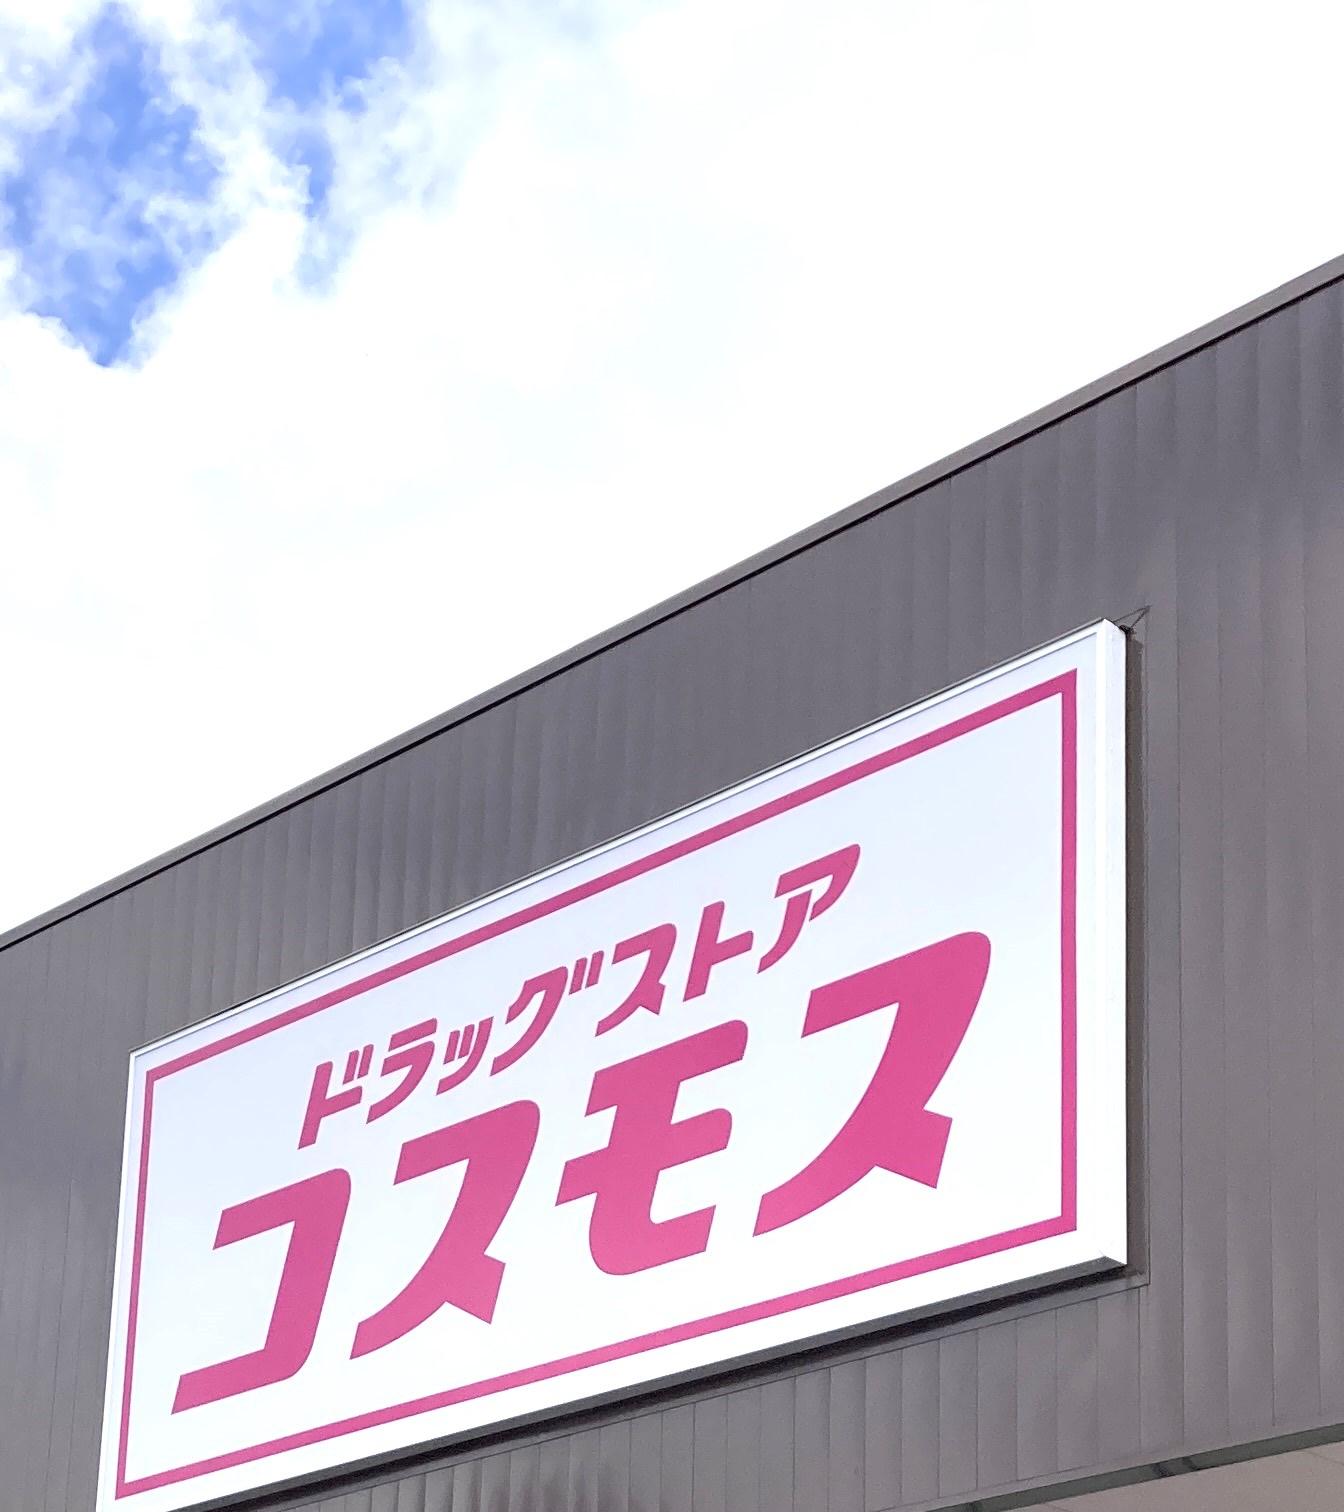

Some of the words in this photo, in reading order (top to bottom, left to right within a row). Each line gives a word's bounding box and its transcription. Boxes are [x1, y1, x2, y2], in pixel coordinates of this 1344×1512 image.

[170, 930, 992, 1415] コスモス
[297, 842, 862, 1149] ドラッグストア
